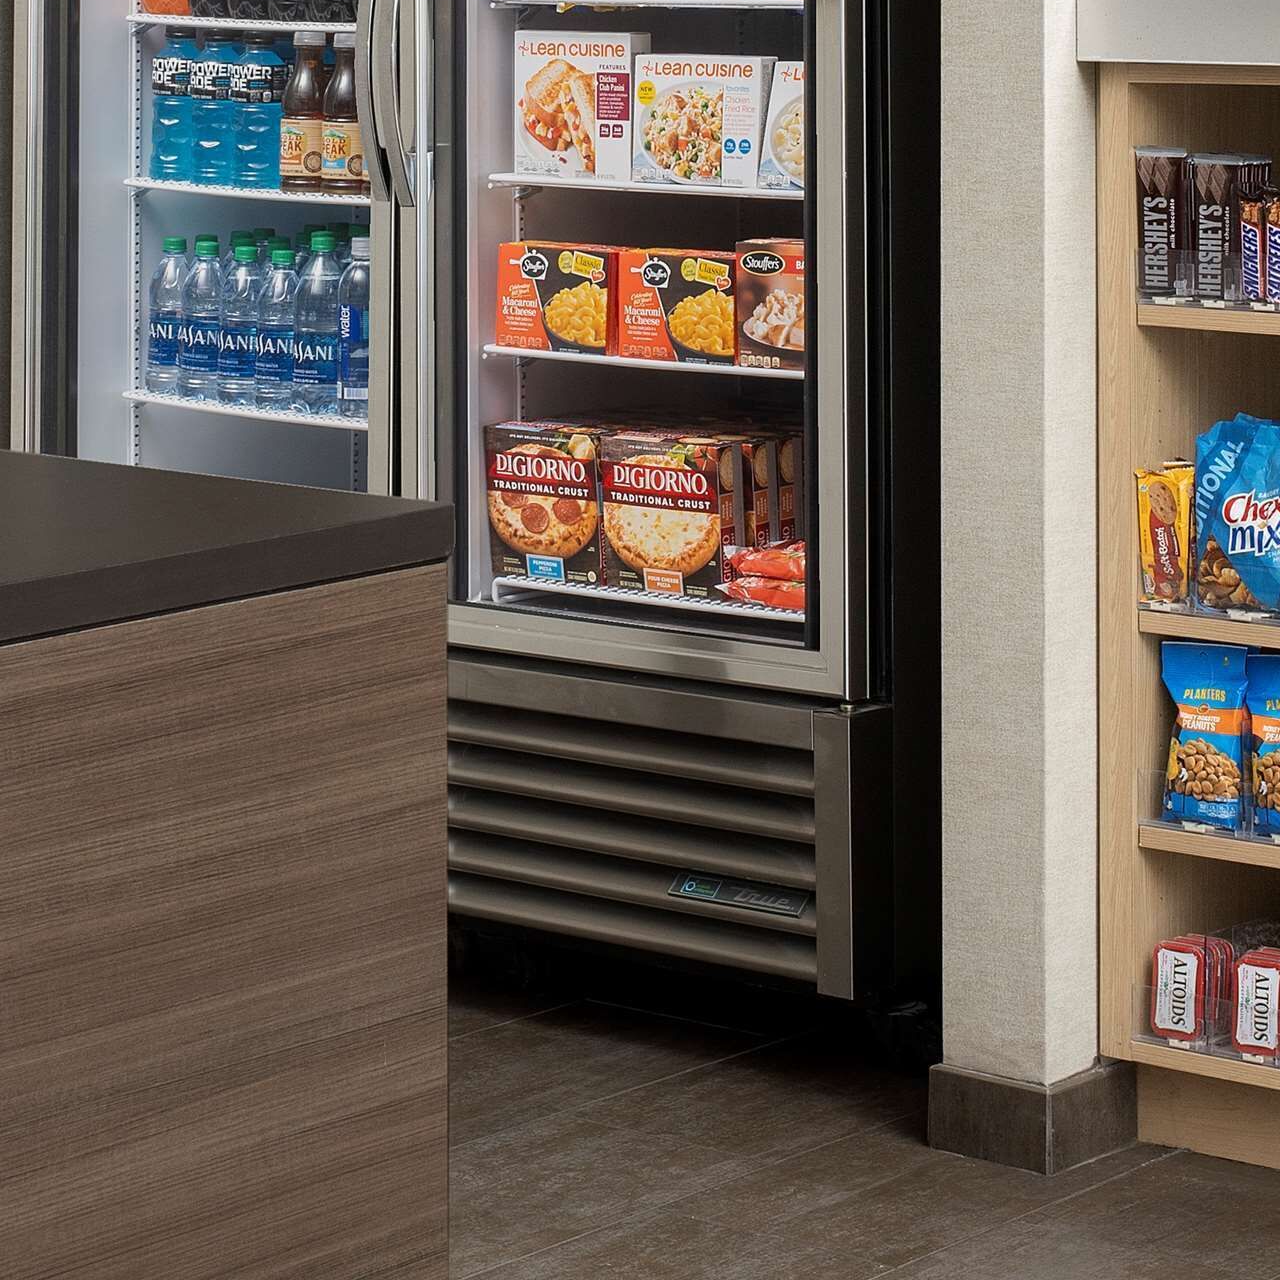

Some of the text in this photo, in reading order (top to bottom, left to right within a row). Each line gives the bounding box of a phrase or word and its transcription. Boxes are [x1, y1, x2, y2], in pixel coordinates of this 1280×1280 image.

[1143, 196, 1168, 287] HERSHEY'S
[1198, 204, 1223, 297] HERSHEY'S
[745, 256, 780, 271] Stouffer's
[1241, 224, 1261, 299] SNICKERS
[502, 295, 538, 308] Macaroni
[624, 305, 661, 316] Macaroni
[494, 480, 589, 497] TRADITIONAL CRUST
[611, 491, 711, 510] TRADITIONAL CRUST
[1184, 687, 1226, 702] PLANTERS
[1182, 720, 1216, 732] PEANUTS
[1171, 957, 1188, 1027] ALTOIDS
[1254, 972, 1270, 1043] ALTOIDS
